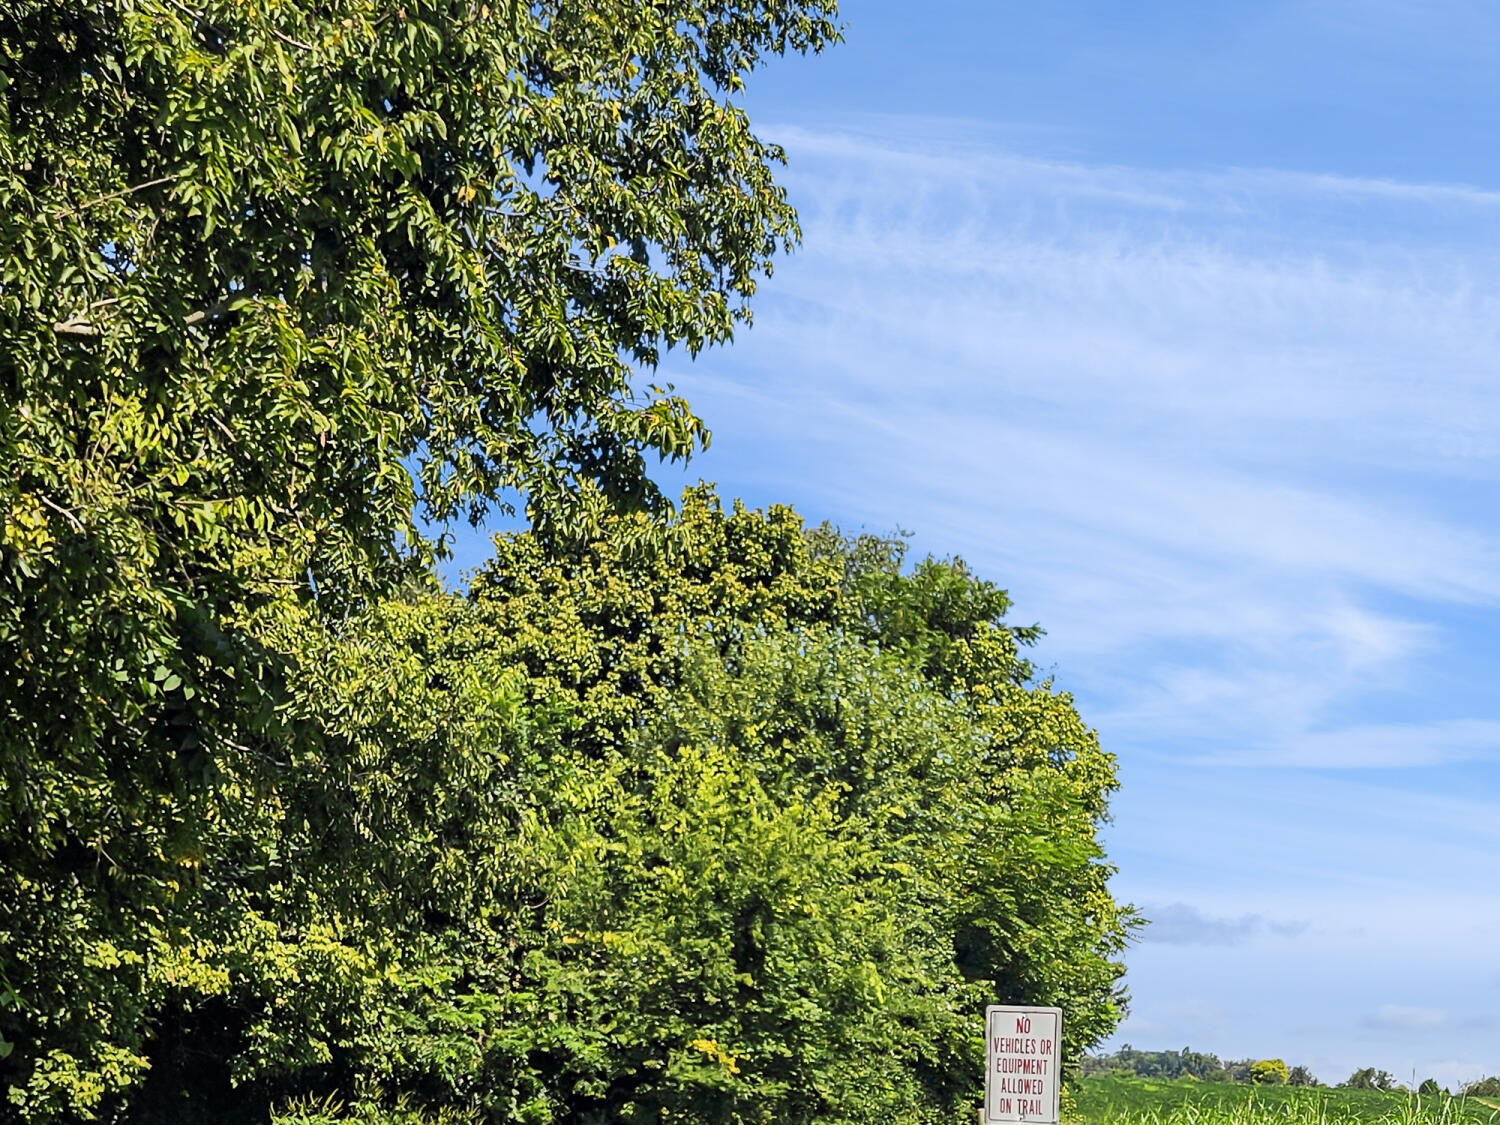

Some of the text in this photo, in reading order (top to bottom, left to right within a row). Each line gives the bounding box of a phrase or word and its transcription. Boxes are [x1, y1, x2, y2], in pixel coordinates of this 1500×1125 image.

[1016, 1018, 1031, 1034] NO
[994, 1037, 1052, 1055] VEHICLES OR
[996, 1058, 1048, 1075] EQUIPMENT
[1001, 1078, 1043, 1095] ALLOWED
[1000, 1098, 1043, 1115] ON TRAIL
